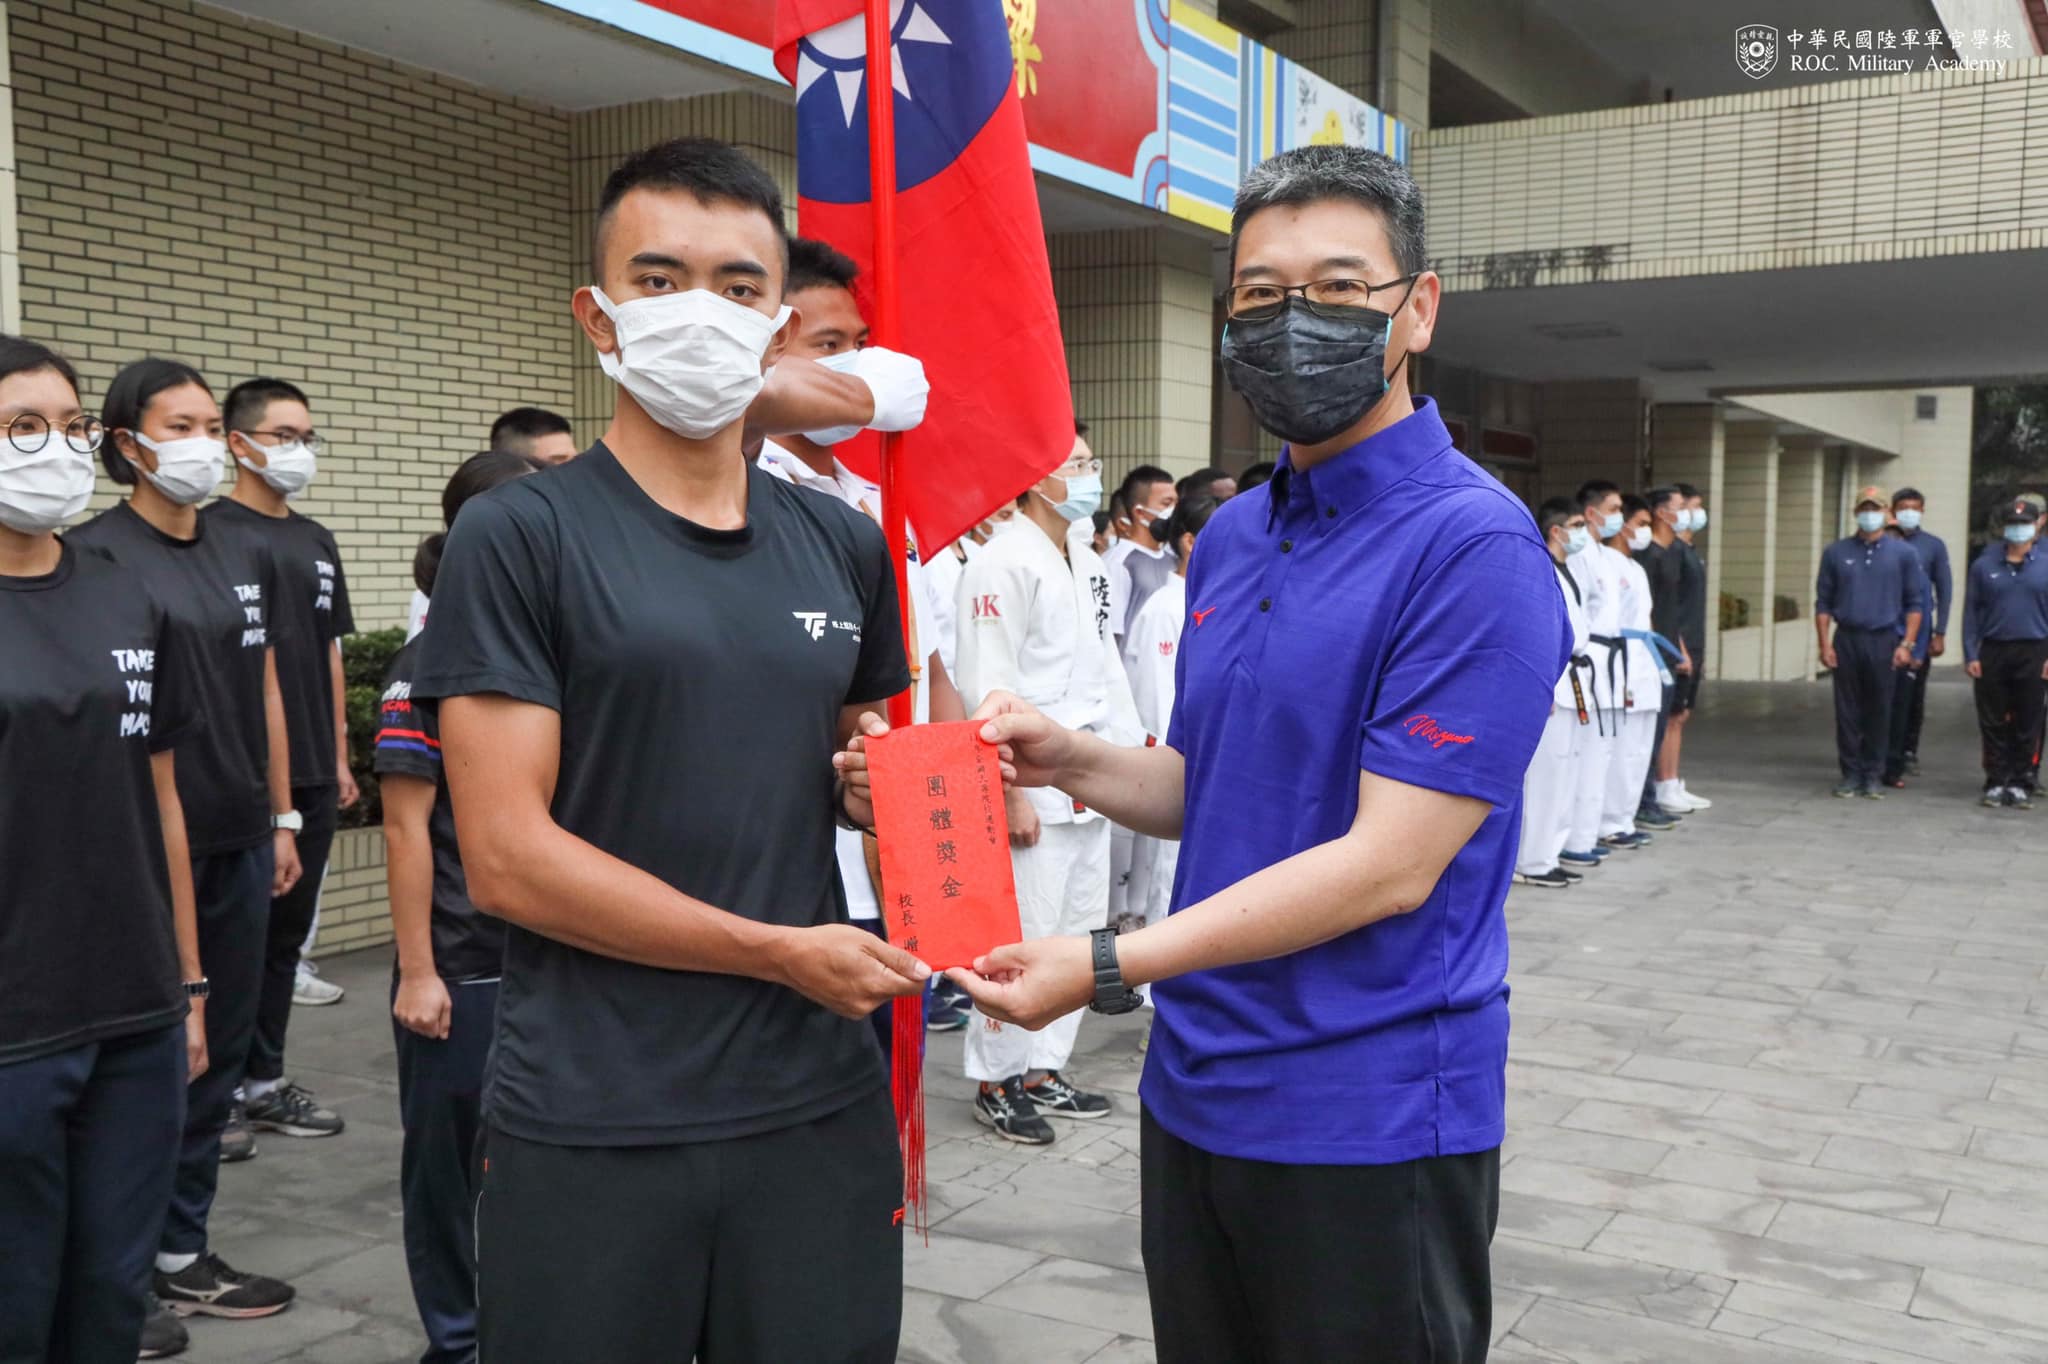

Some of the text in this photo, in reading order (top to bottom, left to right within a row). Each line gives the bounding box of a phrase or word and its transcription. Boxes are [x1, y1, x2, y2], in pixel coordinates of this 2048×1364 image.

[111, 649, 155, 672] TAKE
[927, 775, 964, 899] 團體獎金
[897, 892, 917, 928] 校長
